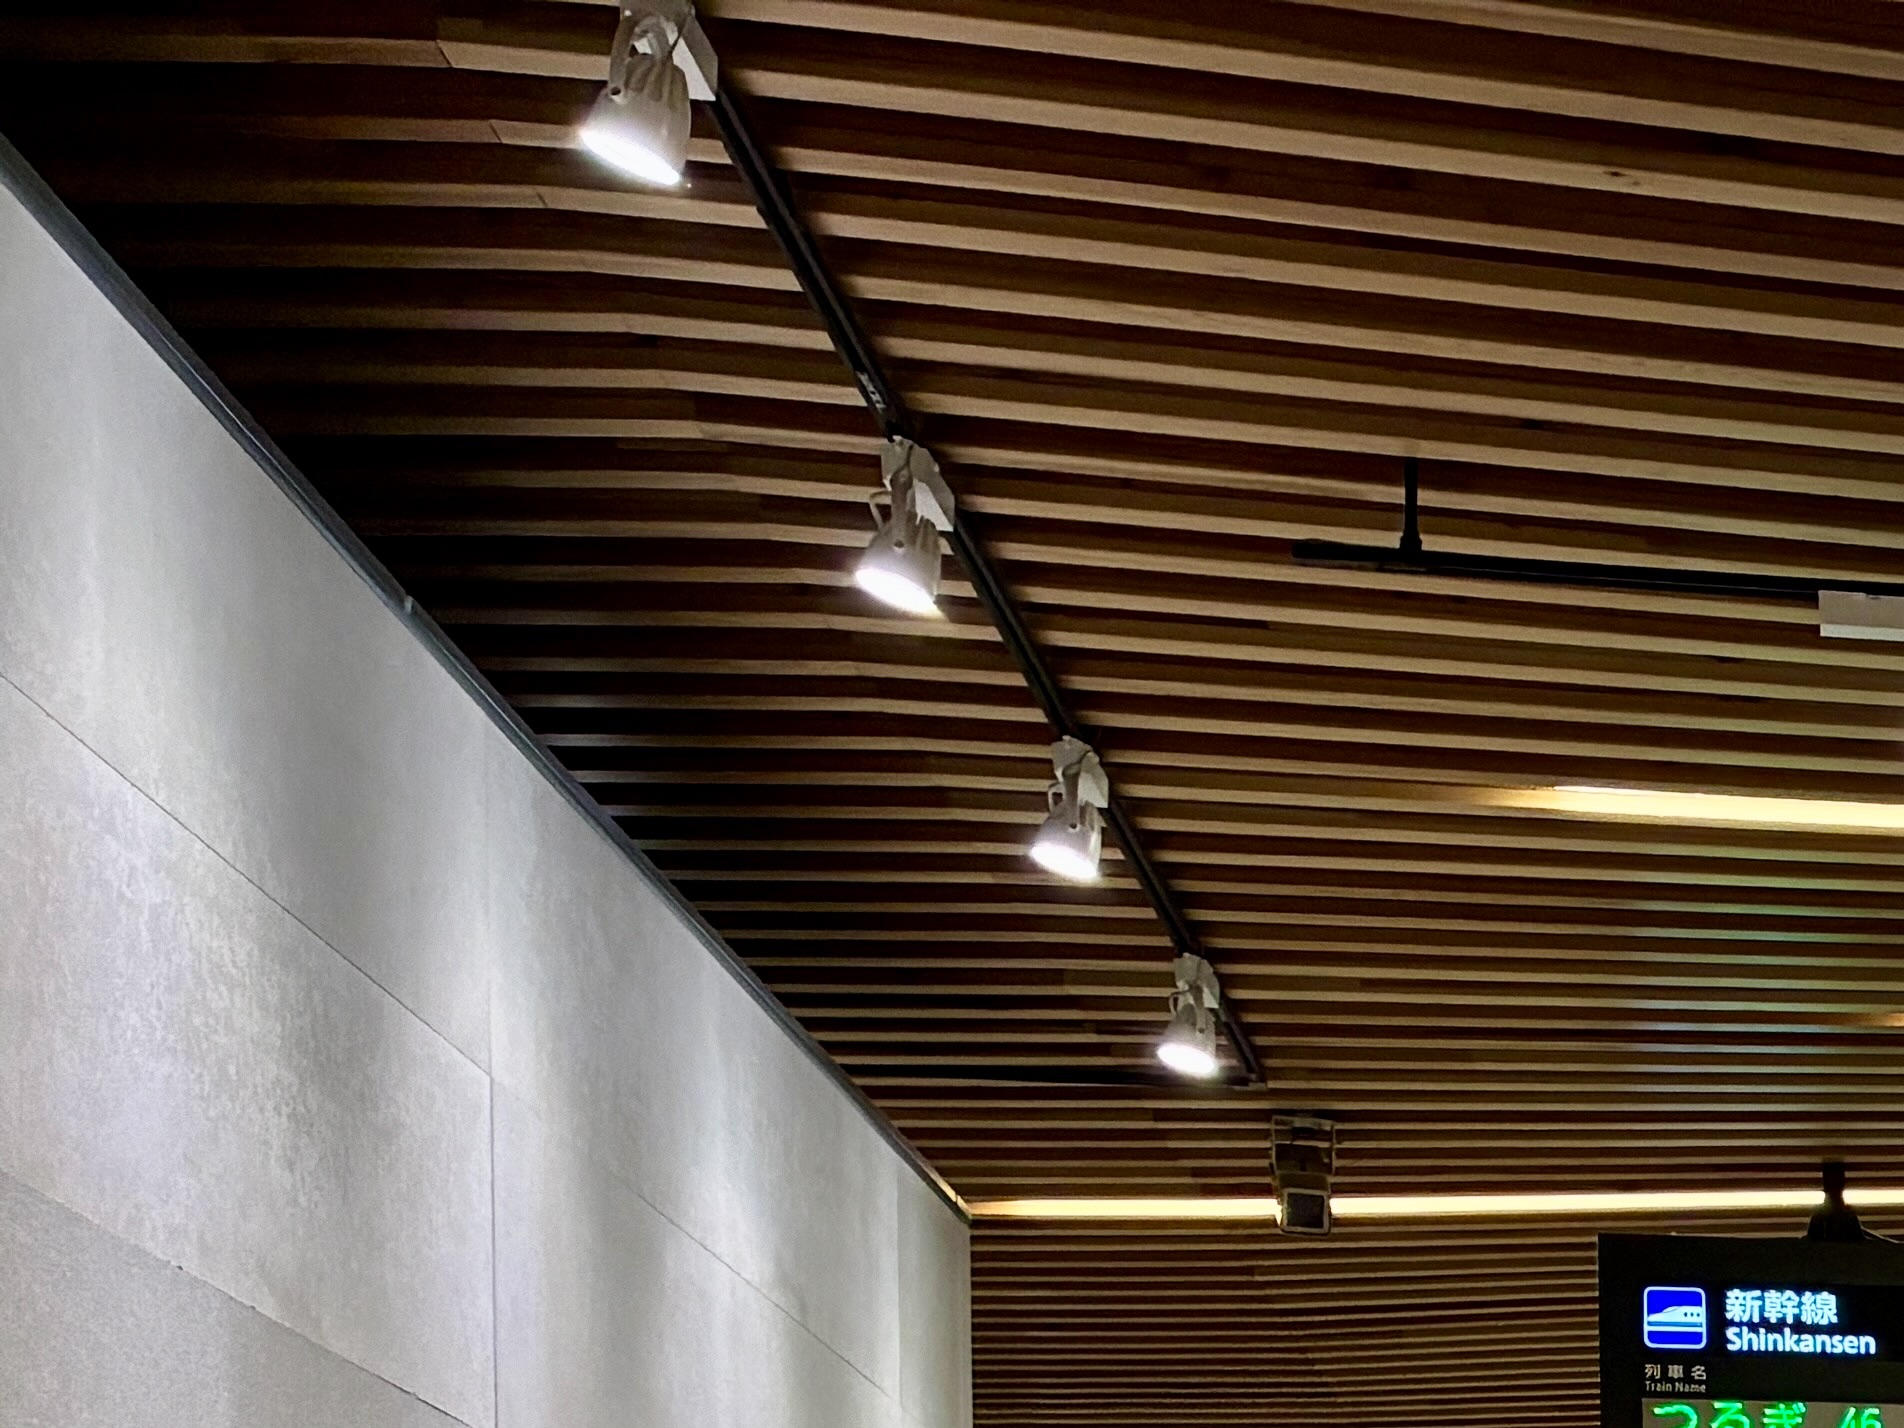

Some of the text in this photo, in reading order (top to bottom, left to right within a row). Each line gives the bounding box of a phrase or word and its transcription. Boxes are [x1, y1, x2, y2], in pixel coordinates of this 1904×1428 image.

[1725, 1289, 1837, 1324] 新幹線
[1725, 1328, 1876, 1355] Shinkansen
[1644, 1365, 1706, 1379] 列車名
[1645, 1382, 1671, 1392] Train
[1675, 1382, 1706, 1393] Name
